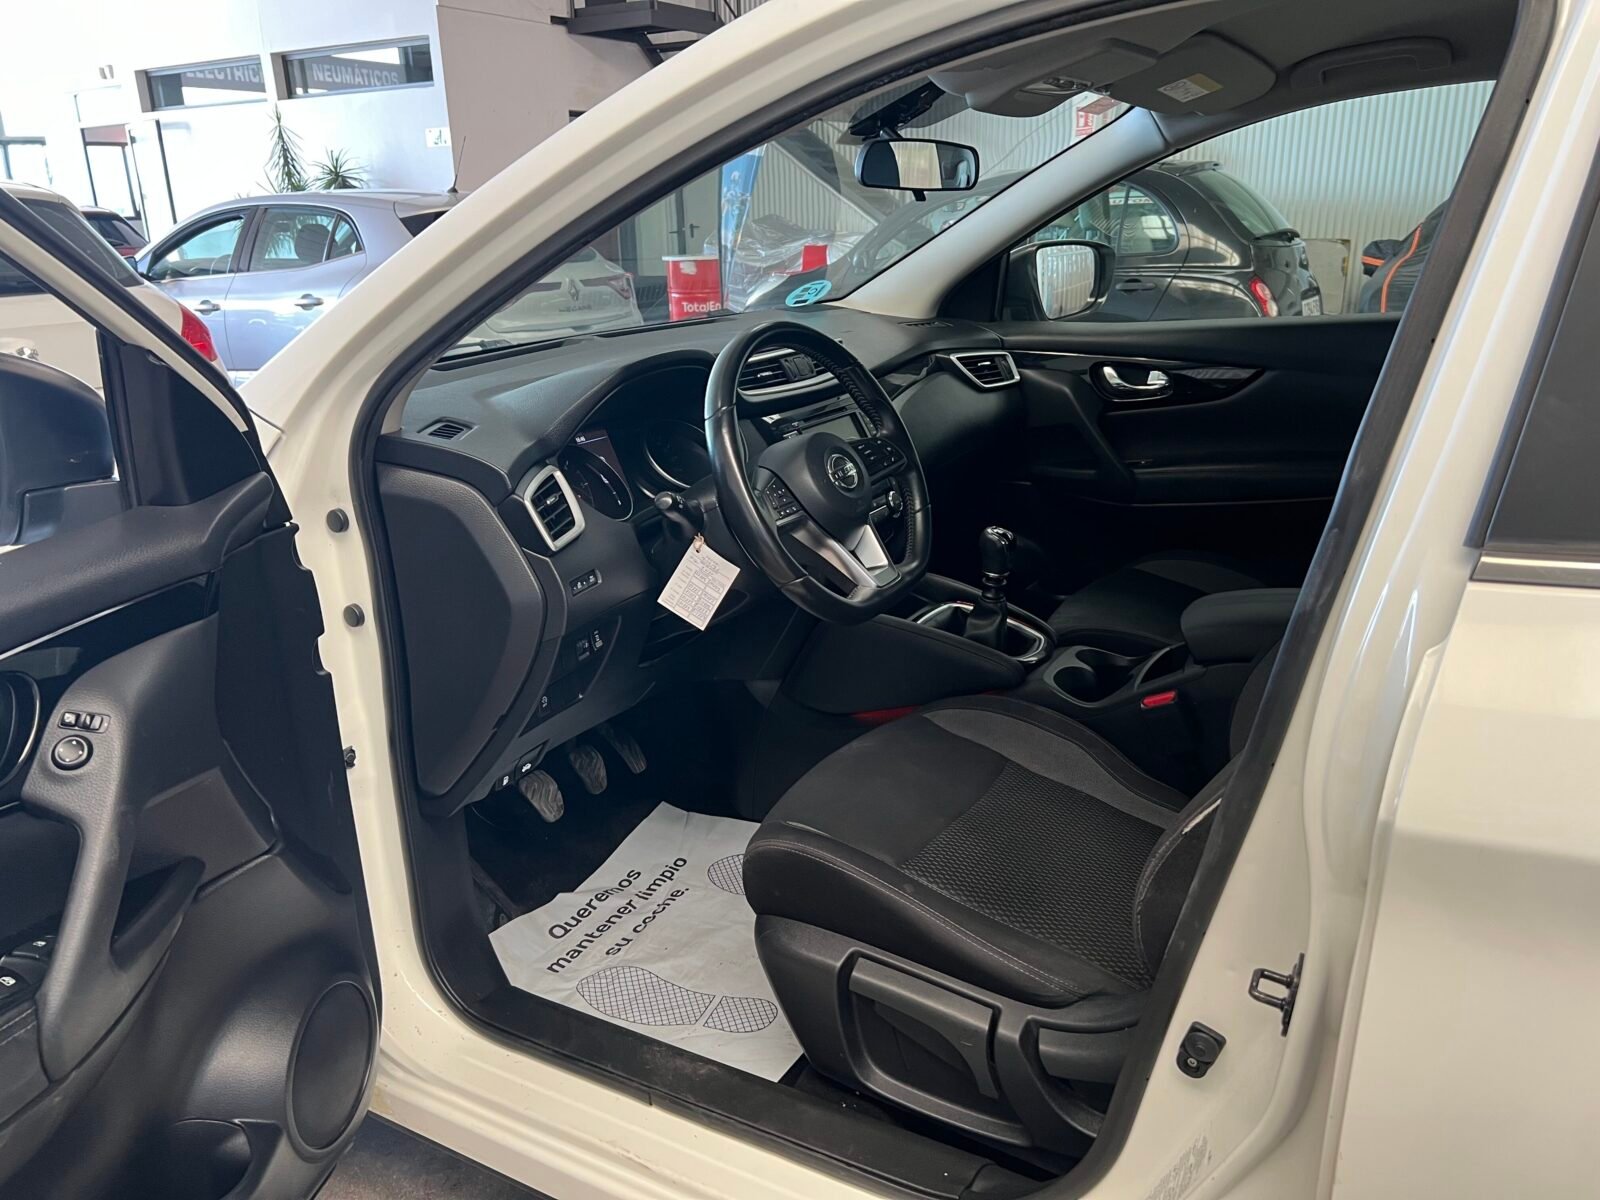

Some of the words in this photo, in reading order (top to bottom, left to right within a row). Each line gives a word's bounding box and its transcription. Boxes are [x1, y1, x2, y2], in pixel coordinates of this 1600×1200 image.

[311, 63, 399, 86] NEUMÁTICOS
[546, 899, 638, 973] mantener
[635, 857, 688, 901] limpio
[548, 869, 642, 939] Queremos
[605, 937, 634, 956] su
[632, 887, 690, 934] coche.
